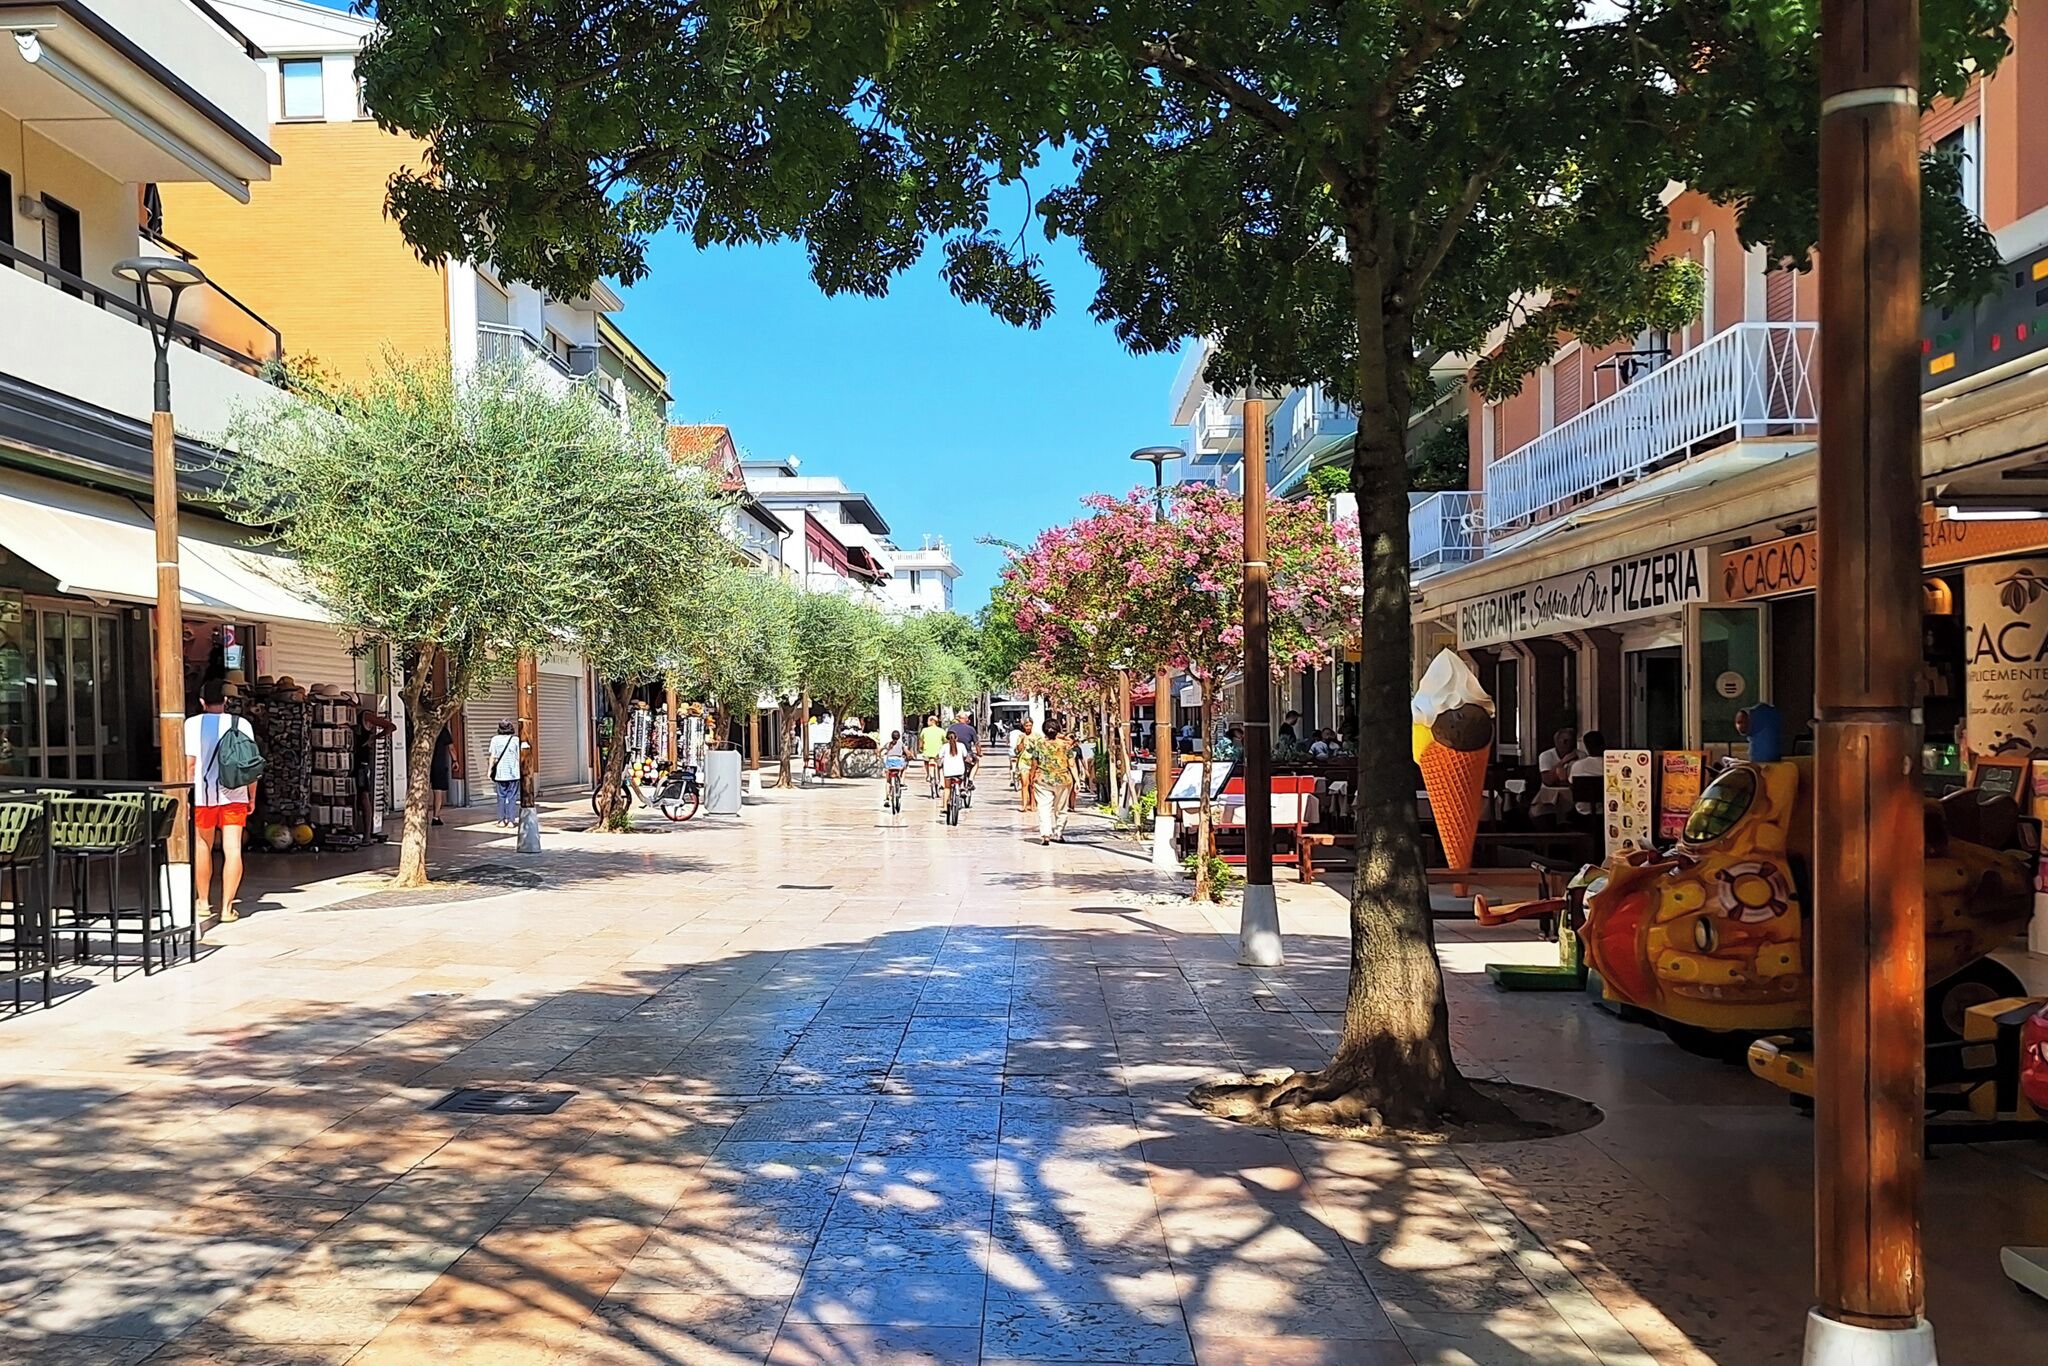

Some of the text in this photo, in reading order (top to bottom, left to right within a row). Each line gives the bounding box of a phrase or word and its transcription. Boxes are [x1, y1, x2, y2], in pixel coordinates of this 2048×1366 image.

[1921, 521, 1967, 549] ELATO
[1742, 542, 1806, 594] CACAO
[1462, 590, 1527, 642] RISTORANTE
[1611, 548, 1701, 614] PIZZERIA
[1966, 621, 2048, 665] ACA
